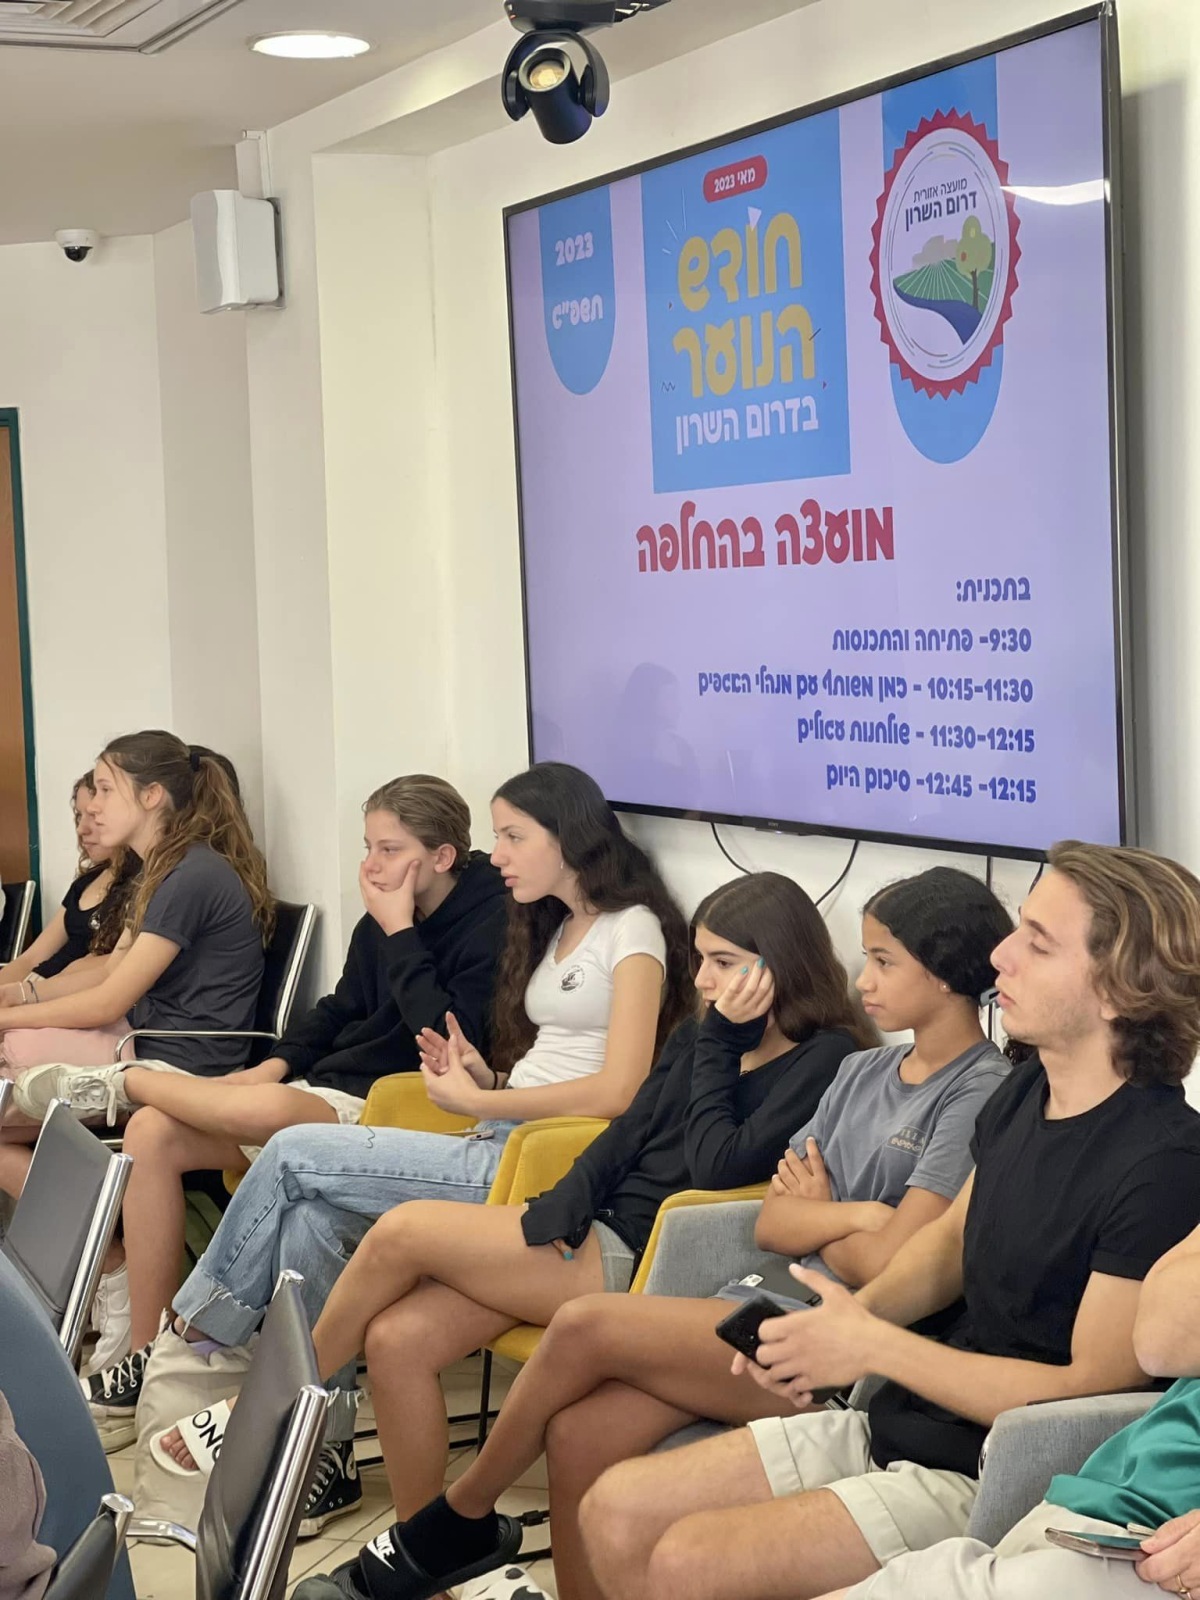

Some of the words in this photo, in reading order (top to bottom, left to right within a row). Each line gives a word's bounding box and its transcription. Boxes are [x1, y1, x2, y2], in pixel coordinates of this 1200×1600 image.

[714, 174, 735, 193] 2023
[738, 167, 756, 185] מאי
[940, 178, 968, 196] מועצה
[913, 185, 939, 203] אזורית
[946, 191, 977, 215] דרום
[905, 201, 942, 232] השרון
[555, 231, 594, 266] 2023
[677, 211, 803, 313] חודש
[672, 303, 816, 398] הנוער
[745, 395, 819, 439] בדרום
[676, 408, 740, 455] השרון
[636, 500, 765, 572] בהחלפה
[774, 498, 895, 566] מועצה
[956, 576, 1031, 602] בתכנית:
[832, 628, 909, 652] והתכנסות
[914, 628, 973, 652] פתיחה
[698, 672, 751, 697] האגפים
[755, 665, 792, 694] מנהלי
[796, 674, 818, 700] עם
[822, 668, 873, 698] משותף
[798, 709, 845, 743] עגולים
[849, 713, 910, 745] שולחנות
[826, 764, 860, 790] היום
[865, 766, 911, 794] סיכום
